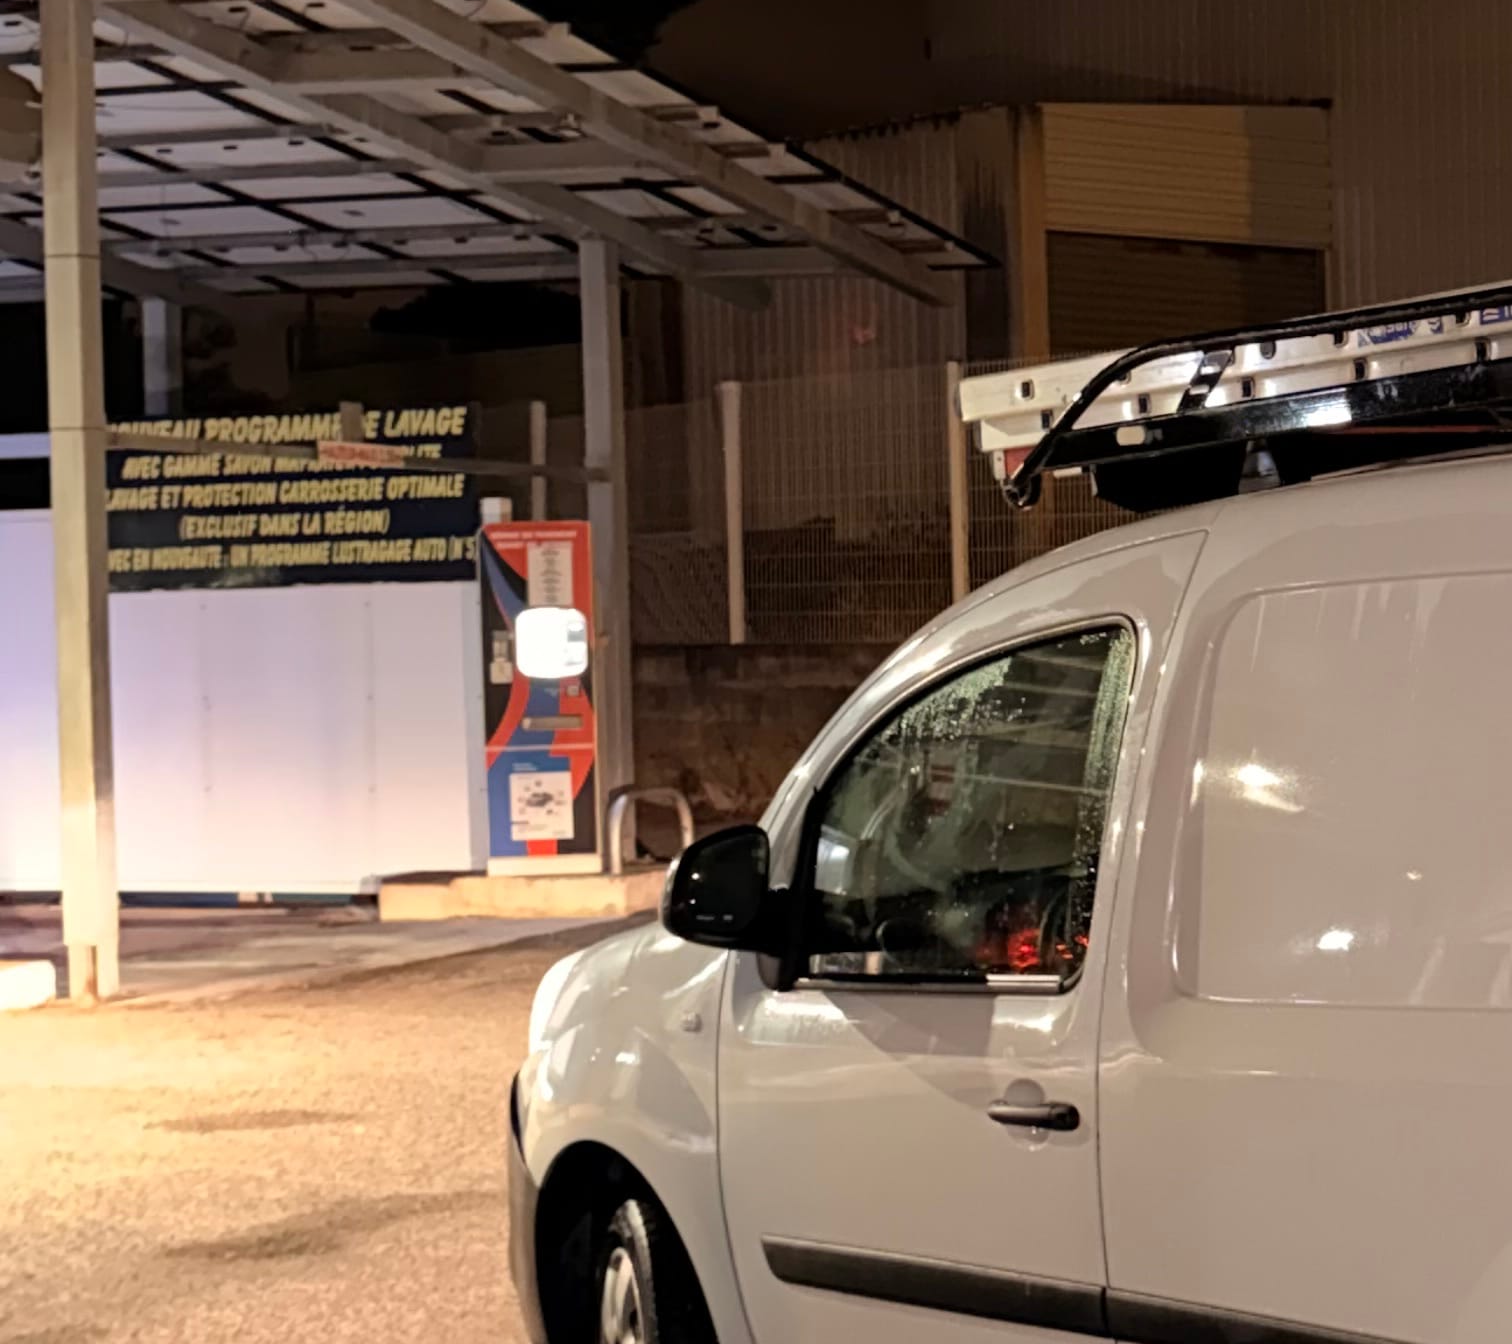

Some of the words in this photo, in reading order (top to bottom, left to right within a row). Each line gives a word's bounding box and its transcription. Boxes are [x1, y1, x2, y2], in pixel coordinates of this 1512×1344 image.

[384, 406, 467, 437] LAVAGE
[121, 455, 161, 480] AVEC
[162, 453, 221, 478] GAMME
[160, 485, 183, 509] ET
[182, 482, 278, 508] PROTECTION
[279, 476, 385, 504] CARROSSERIE
[386, 473, 465, 501] OPTIMALE
[179, 513, 258, 541] (EXCLUSIF
[258, 512, 301, 537] DANS
[302, 511, 322, 536] LA
[323, 505, 391, 536] RÉGION)
